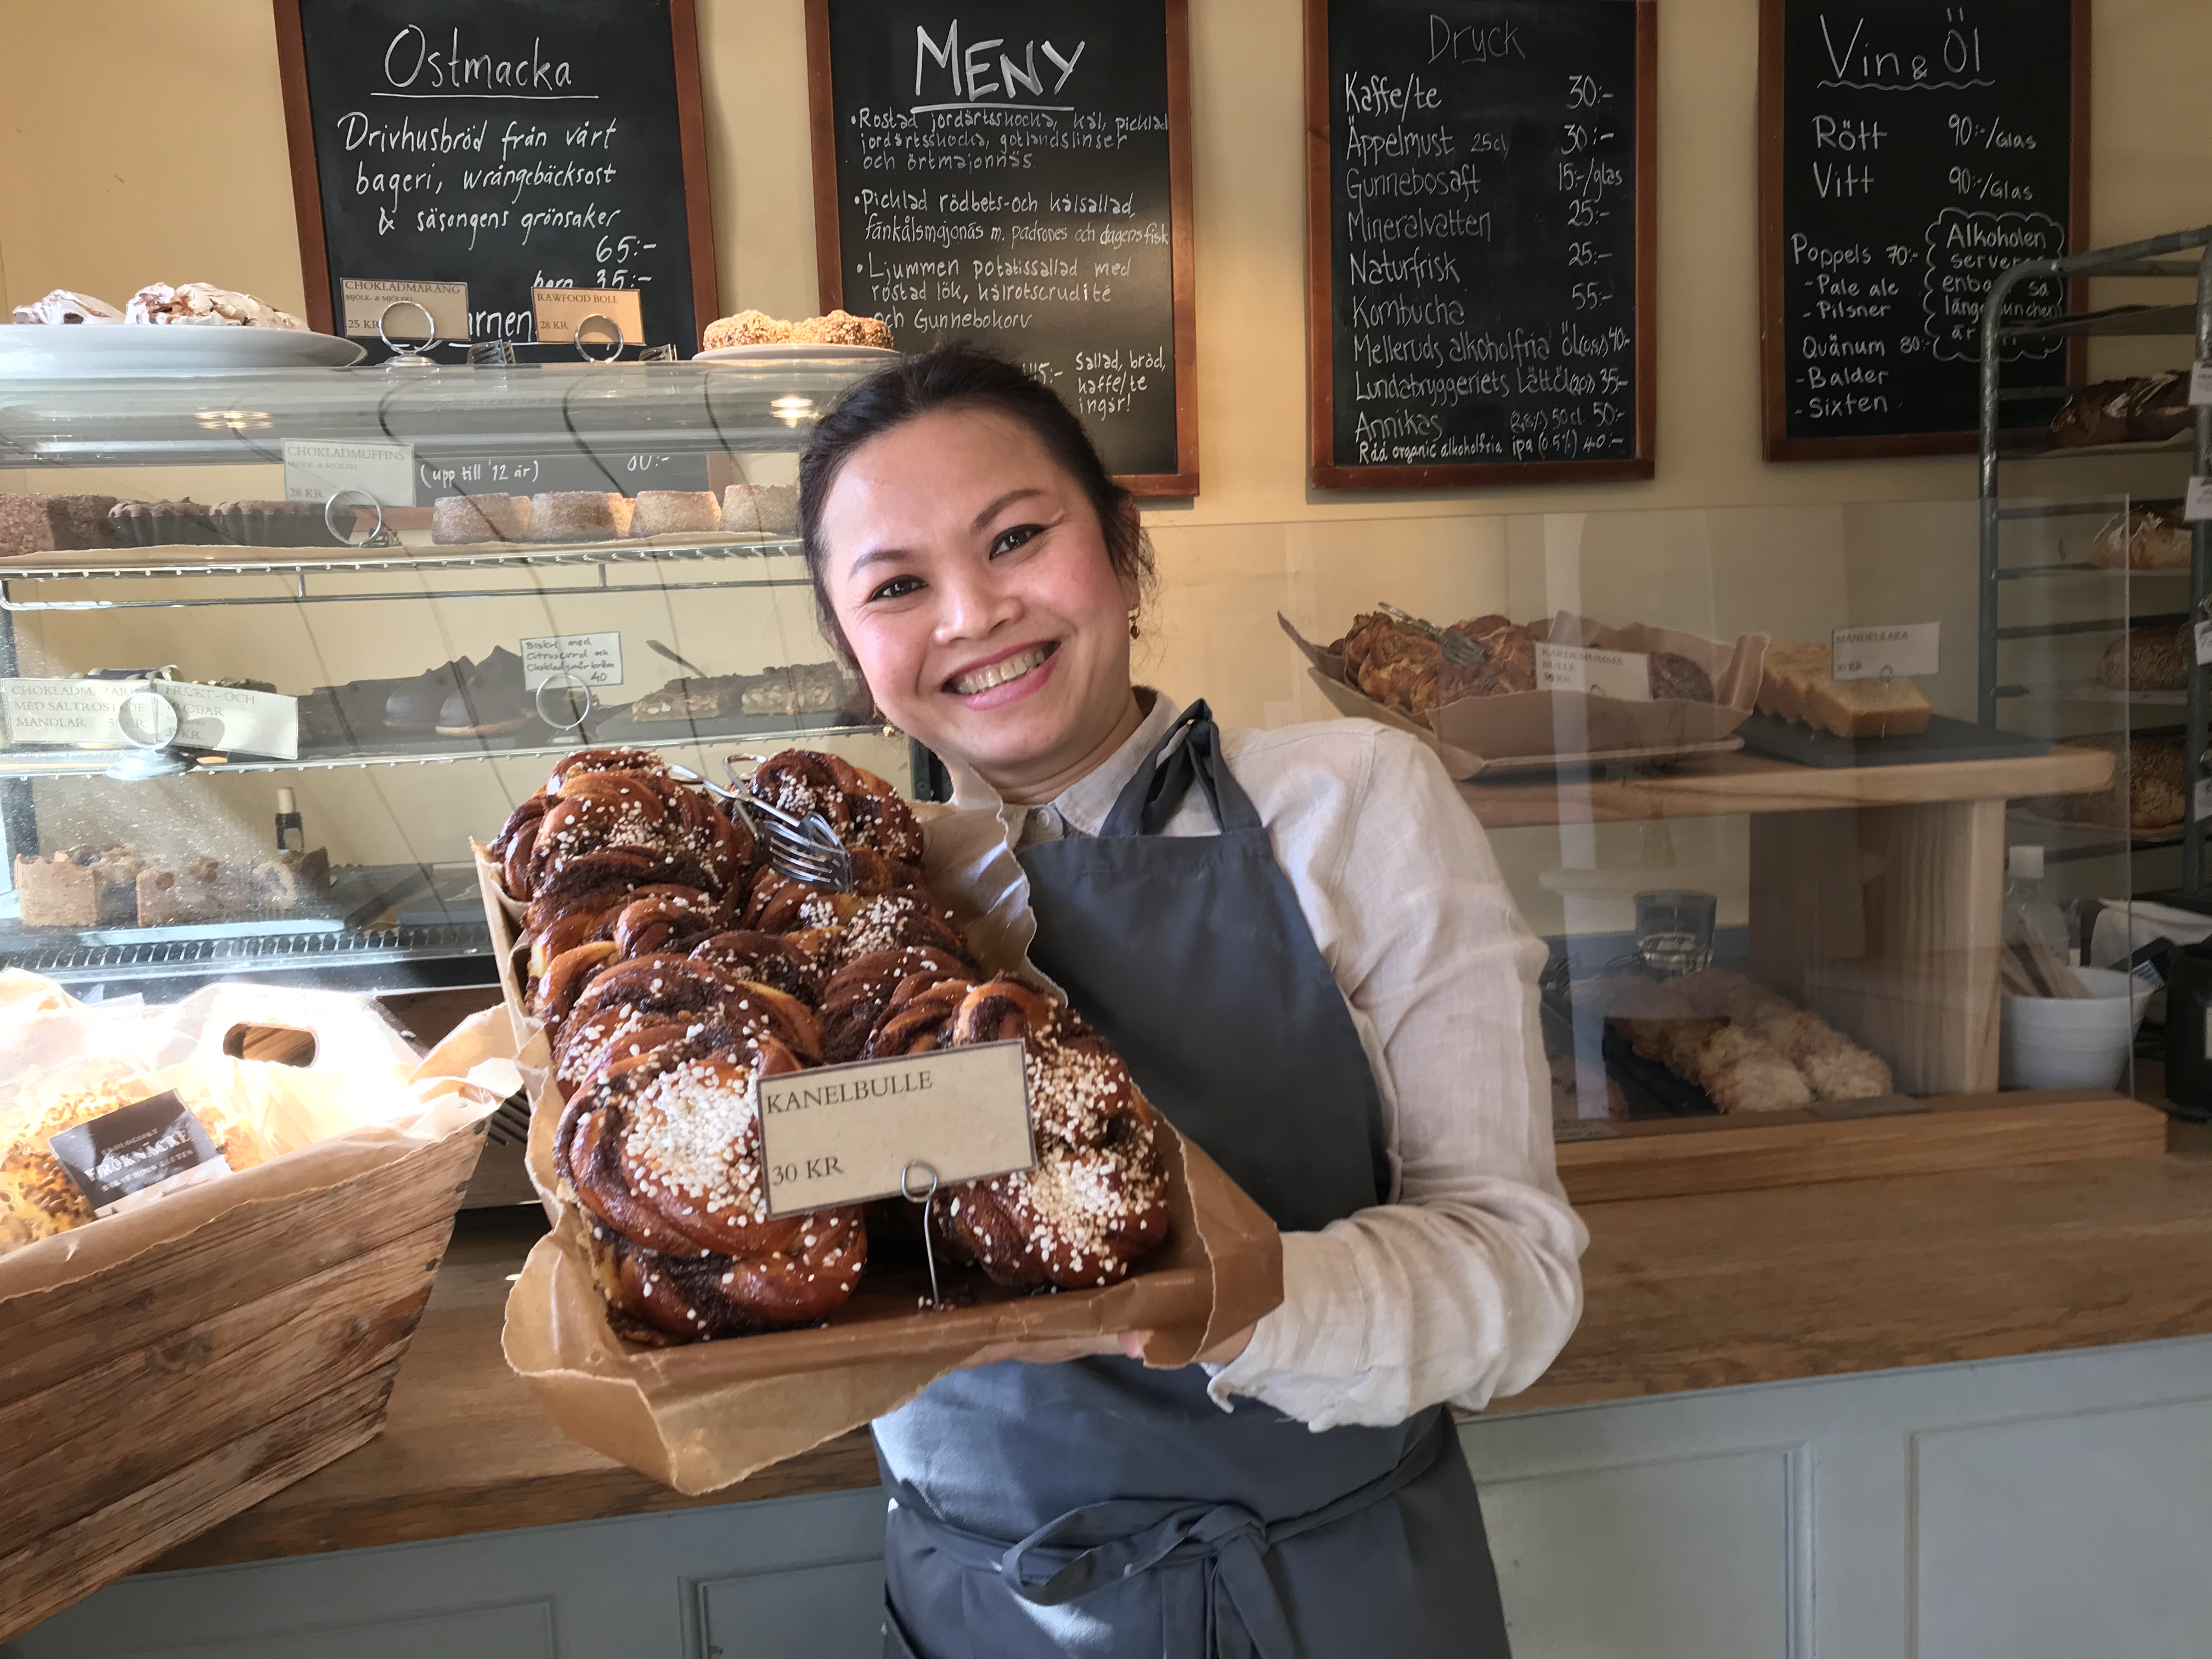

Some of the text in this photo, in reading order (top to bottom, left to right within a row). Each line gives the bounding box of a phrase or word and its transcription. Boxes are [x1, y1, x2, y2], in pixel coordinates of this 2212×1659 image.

[1427, 14, 1525, 64] Dryck
[1819, 6, 1980, 81] Vin & Öl
[385, 25, 572, 91] Ostmacka
[915, 19, 1085, 101] MENY
[1345, 71, 1443, 122] Kaffe/te
[337, 111, 617, 161] Drivhusbröd från vårt
[1000, 129, 1127, 155] gotlandslinser
[1346, 114, 1455, 167] Äppelmust
[1812, 114, 1888, 151] Rött
[863, 149, 895, 171] och
[356, 161, 443, 213] bageri,
[1346, 163, 1481, 205] Gunnebosaft
[1813, 161, 1875, 199] Vitt
[861, 188, 928, 215] Picklad
[379, 202, 621, 251] & säsongens grönsaker
[1074, 222, 1096, 242] och
[1143, 223, 1169, 245] fisk
[1348, 207, 1491, 243] Mineralvatten
[1946, 222, 2046, 249] Alkoholen
[868, 251, 1132, 285] Ljummen potatissallad med
[1350, 246, 1460, 289] Naturfrisk
[1790, 232, 1872, 273] Poppels
[345, 280, 461, 295] CHOKLADMARANG
[537, 293, 619, 303] RAWFOOD BOLL
[1869, 276, 1899, 297] ale
[348, 320, 380, 329] 25 KR
[540, 320, 569, 330] 28 KR
[914, 307, 1032, 334] Gunnebokorv
[1353, 292, 1465, 329] Kombucha
[1354, 332, 1444, 369] Melleruds
[1449, 327, 1550, 368] alkoholfria
[1355, 369, 1510, 407] Lundabryggeriets
[1354, 408, 1443, 443] Annikas
[287, 446, 405, 461] CHOKLADMUFFINS
[1392, 440, 1437, 464] organic
[1440, 432, 1503, 458] alkoholfria
[1512, 435, 1533, 461] ipa
[461, 463, 481, 481] till
[289, 488, 325, 498] 28 KR
[590, 671, 607, 682] 40
[15, 701, 44, 712] MED
[223, 692, 255, 704] OCH
[16, 718, 87, 728] MANDLAR
[766, 1069, 934, 1115] KANELBULLE
[772, 1155, 843, 1187] 30 KR
